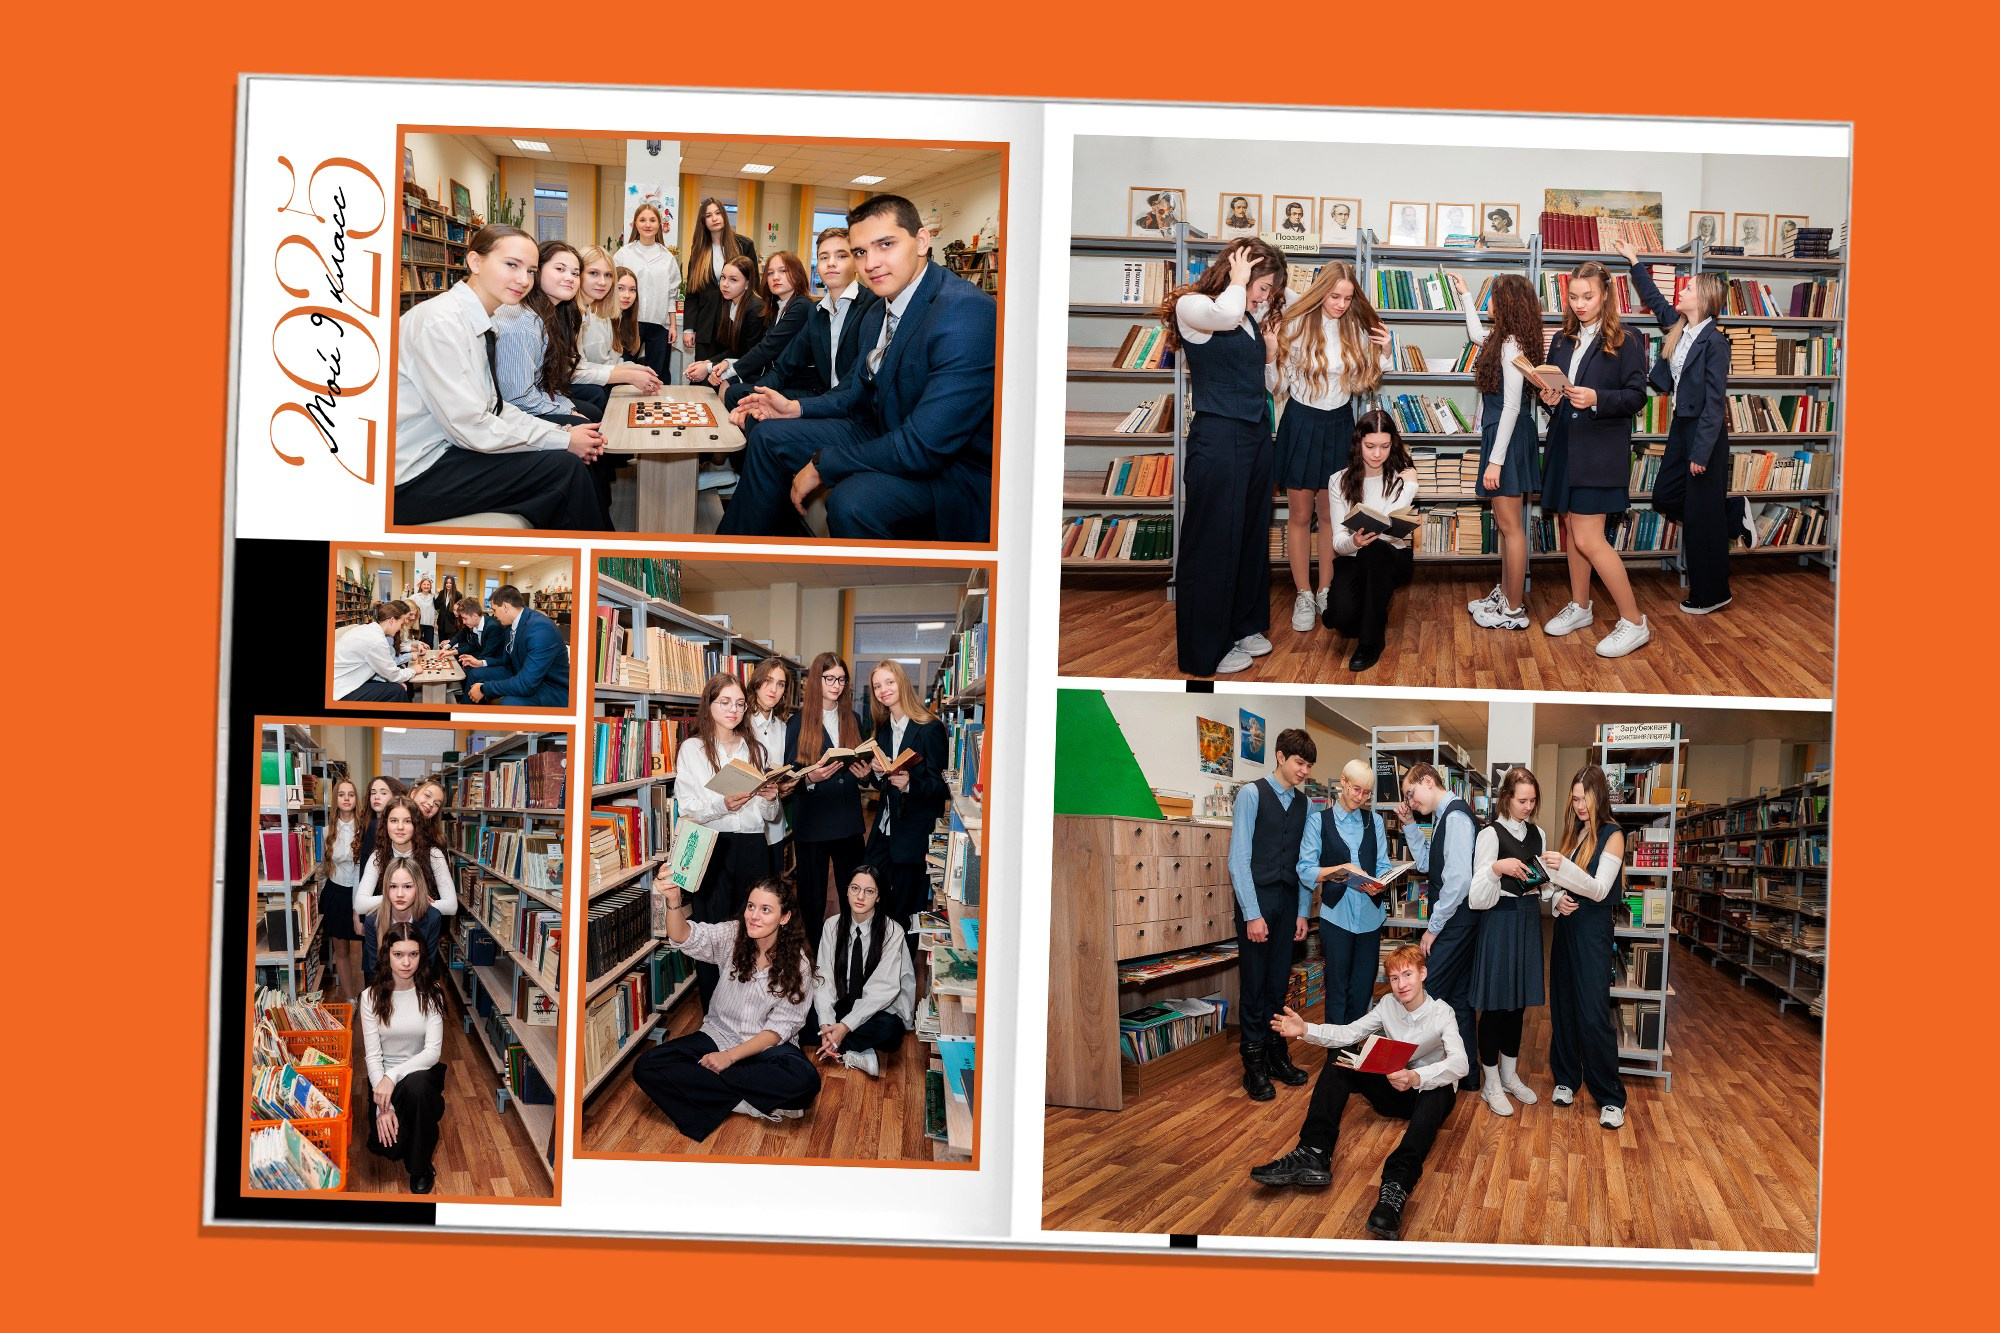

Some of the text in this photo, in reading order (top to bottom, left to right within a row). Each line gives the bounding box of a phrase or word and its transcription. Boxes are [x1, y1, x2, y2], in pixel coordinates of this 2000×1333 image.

[1275, 232, 1305, 241] Поэзия
[269, 155, 386, 486] 2025
[305, 186, 347, 454] Мой 9 класс
[1620, 723, 1668, 733] Зарубежная
[288, 788, 302, 803] Д
